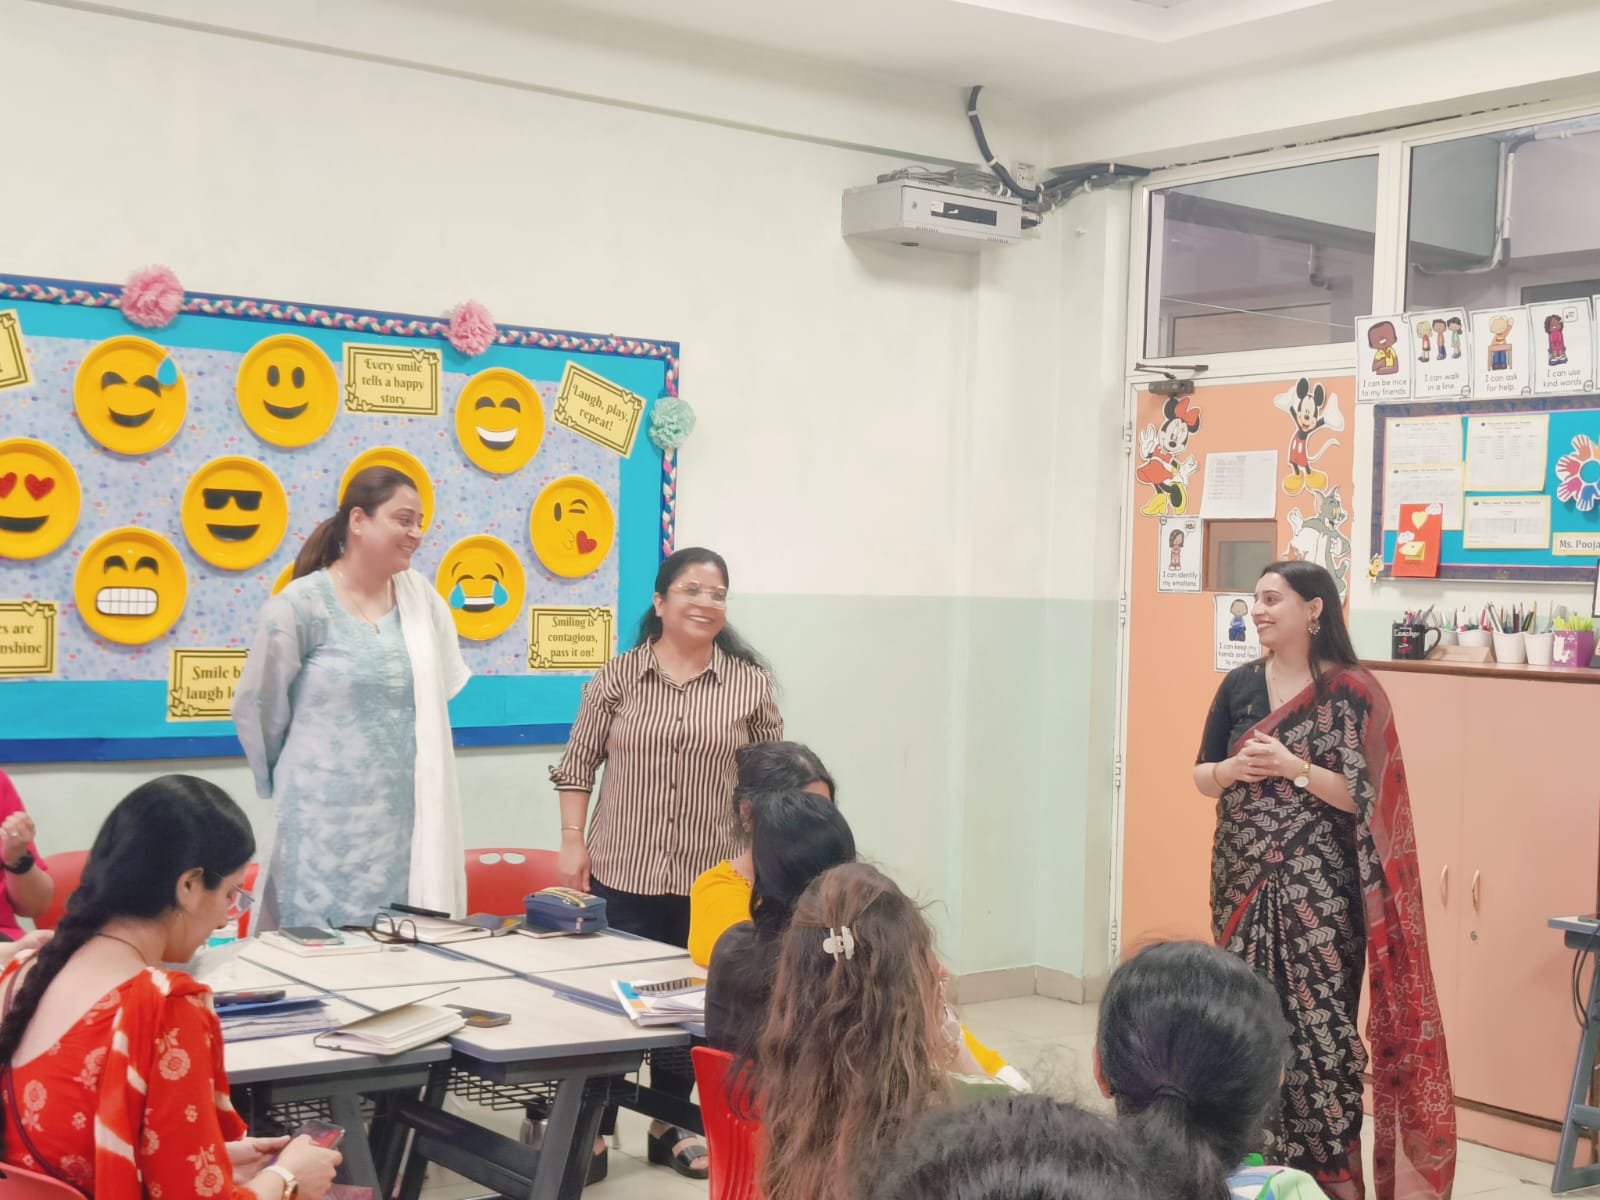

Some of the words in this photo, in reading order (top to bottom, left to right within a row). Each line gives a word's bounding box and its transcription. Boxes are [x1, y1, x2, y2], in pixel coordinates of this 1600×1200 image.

[364, 358, 393, 374] Every
[396, 360, 423, 373] smile
[362, 374, 382, 386] tells
[385, 379, 391, 387] a
[394, 376, 424, 391] happy
[1444, 372, 1460, 380] walk
[380, 394, 406, 405] story
[579, 408, 614, 431] repeat!
[1559, 539, 1574, 549] Ms.
[552, 616, 586, 629] Smiling
[588, 617, 595, 627] is
[12, 625, 34, 635] are
[547, 633, 598, 645] contagious,
[550, 648, 569, 660] pass
[571, 647, 578, 657] it
[580, 647, 595, 657] on!
[192, 665, 230, 680] Smile
[186, 686, 224, 703] laugh
